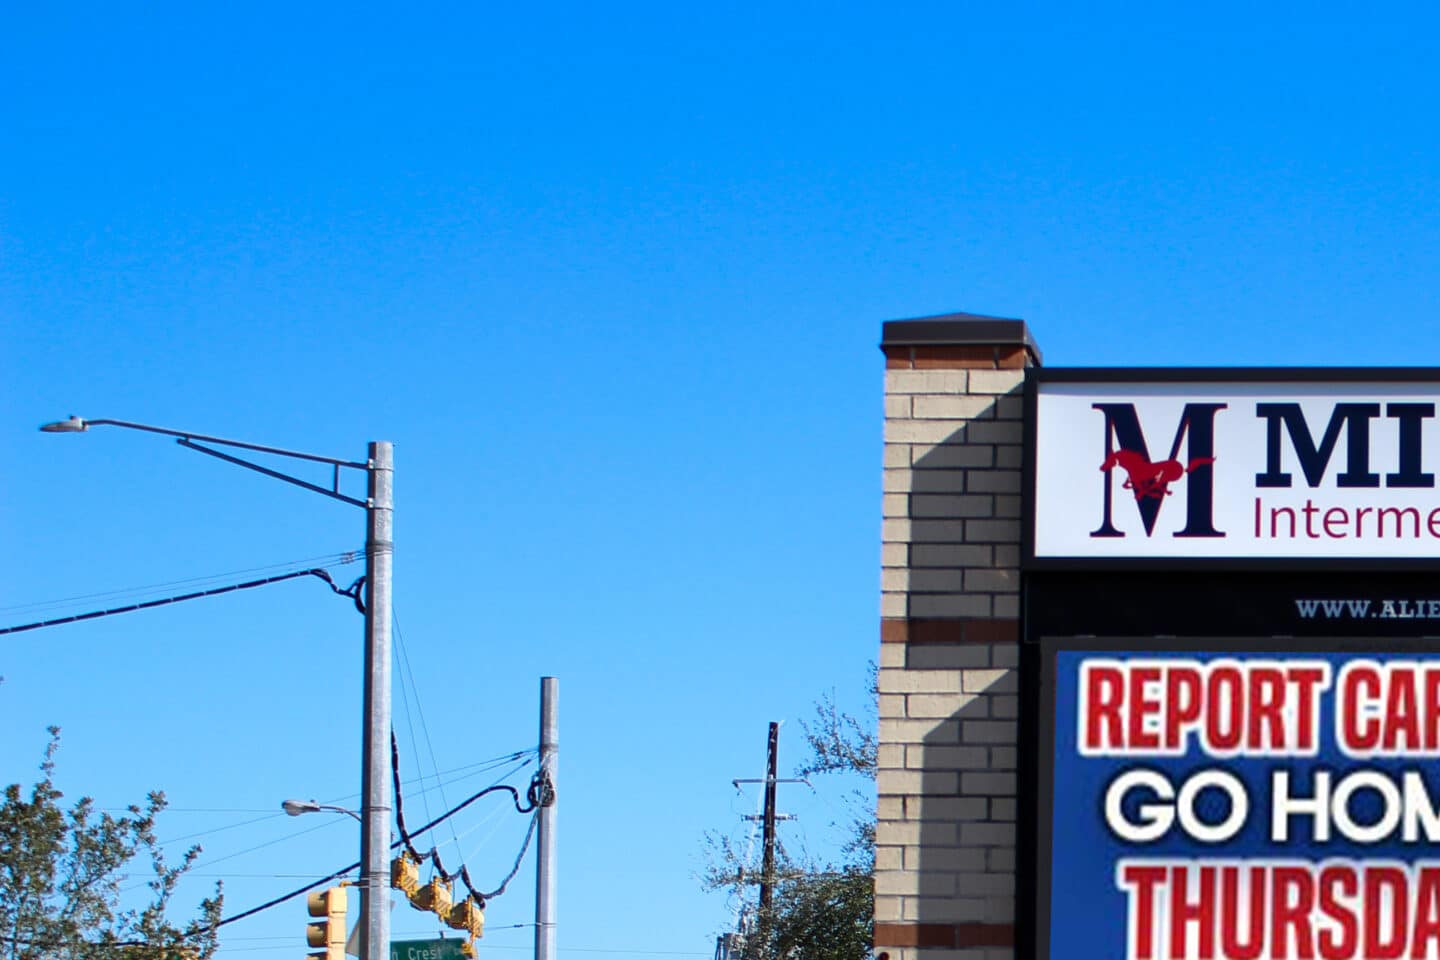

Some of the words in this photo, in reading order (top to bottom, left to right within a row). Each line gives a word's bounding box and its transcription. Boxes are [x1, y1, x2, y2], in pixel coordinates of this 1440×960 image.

[1090, 403, 1228, 537] M
[1082, 663, 1327, 752] REPORT
[1105, 769, 1248, 842] GO
